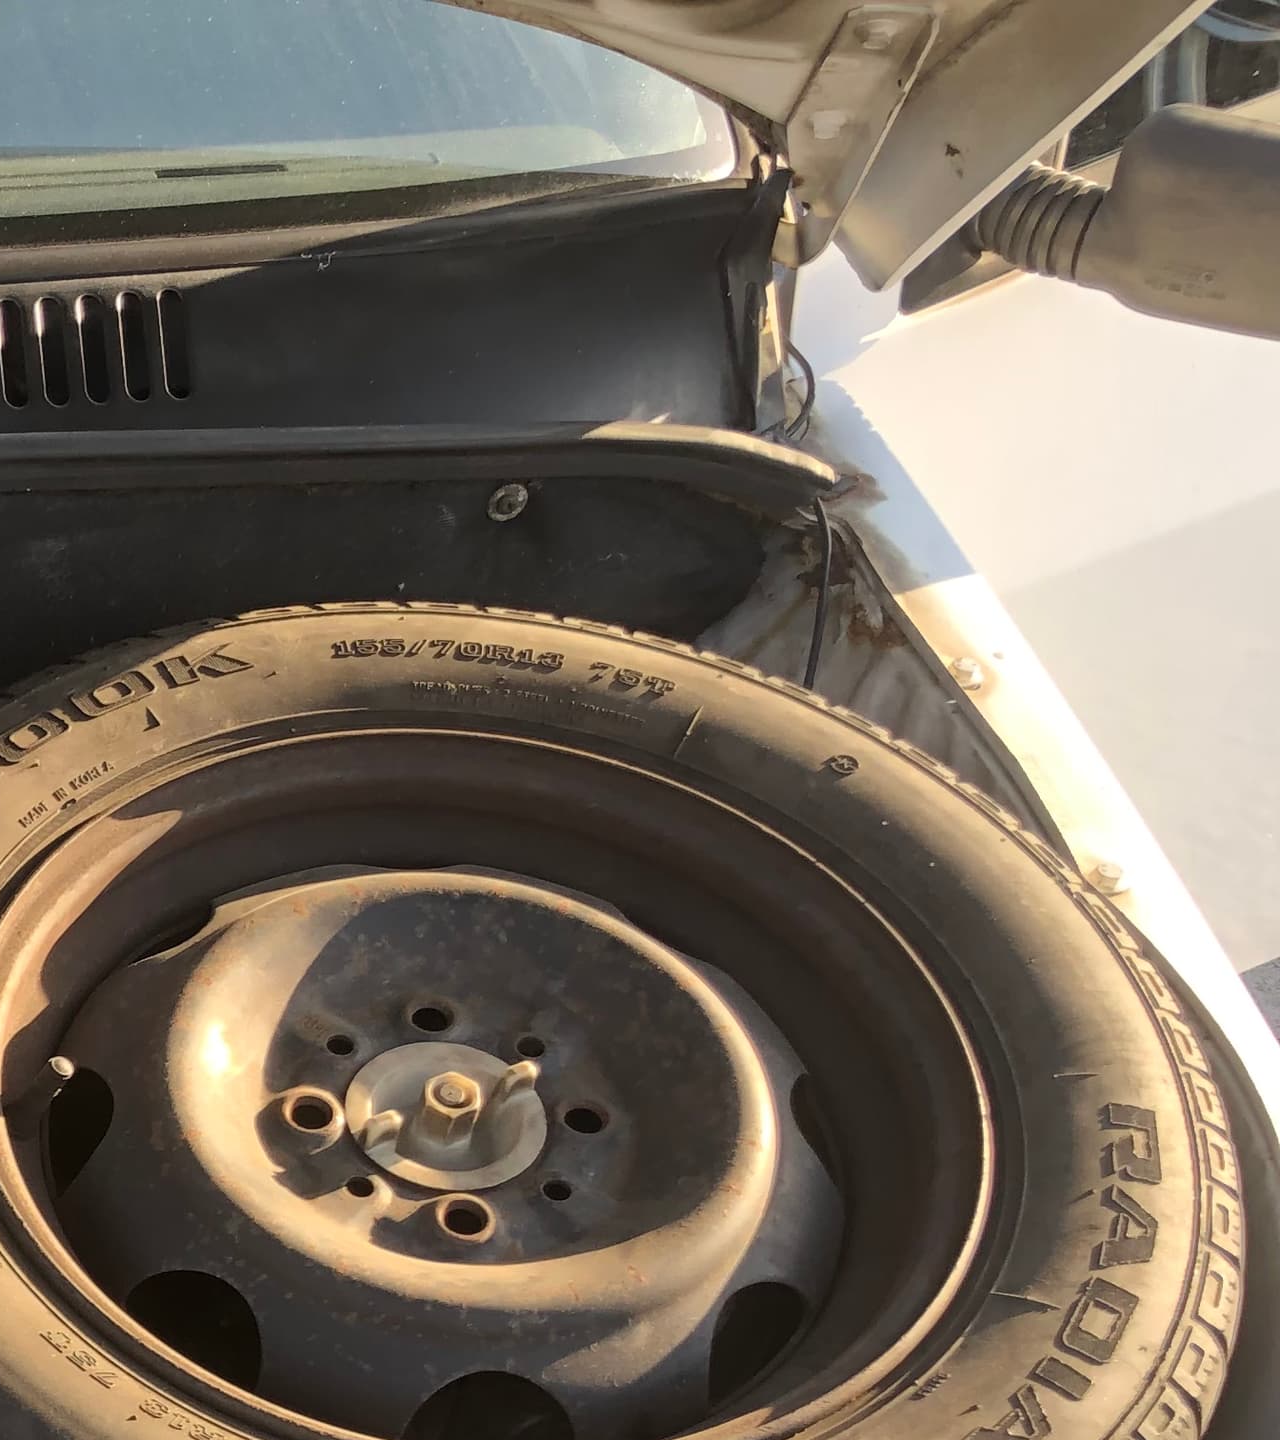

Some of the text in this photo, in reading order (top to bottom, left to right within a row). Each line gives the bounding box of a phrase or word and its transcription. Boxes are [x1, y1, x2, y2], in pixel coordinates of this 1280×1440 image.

[332, 639, 675, 696] 155/70R13 75T
[18, 802, 48, 828] MADE
[52, 787, 68, 802] IN
